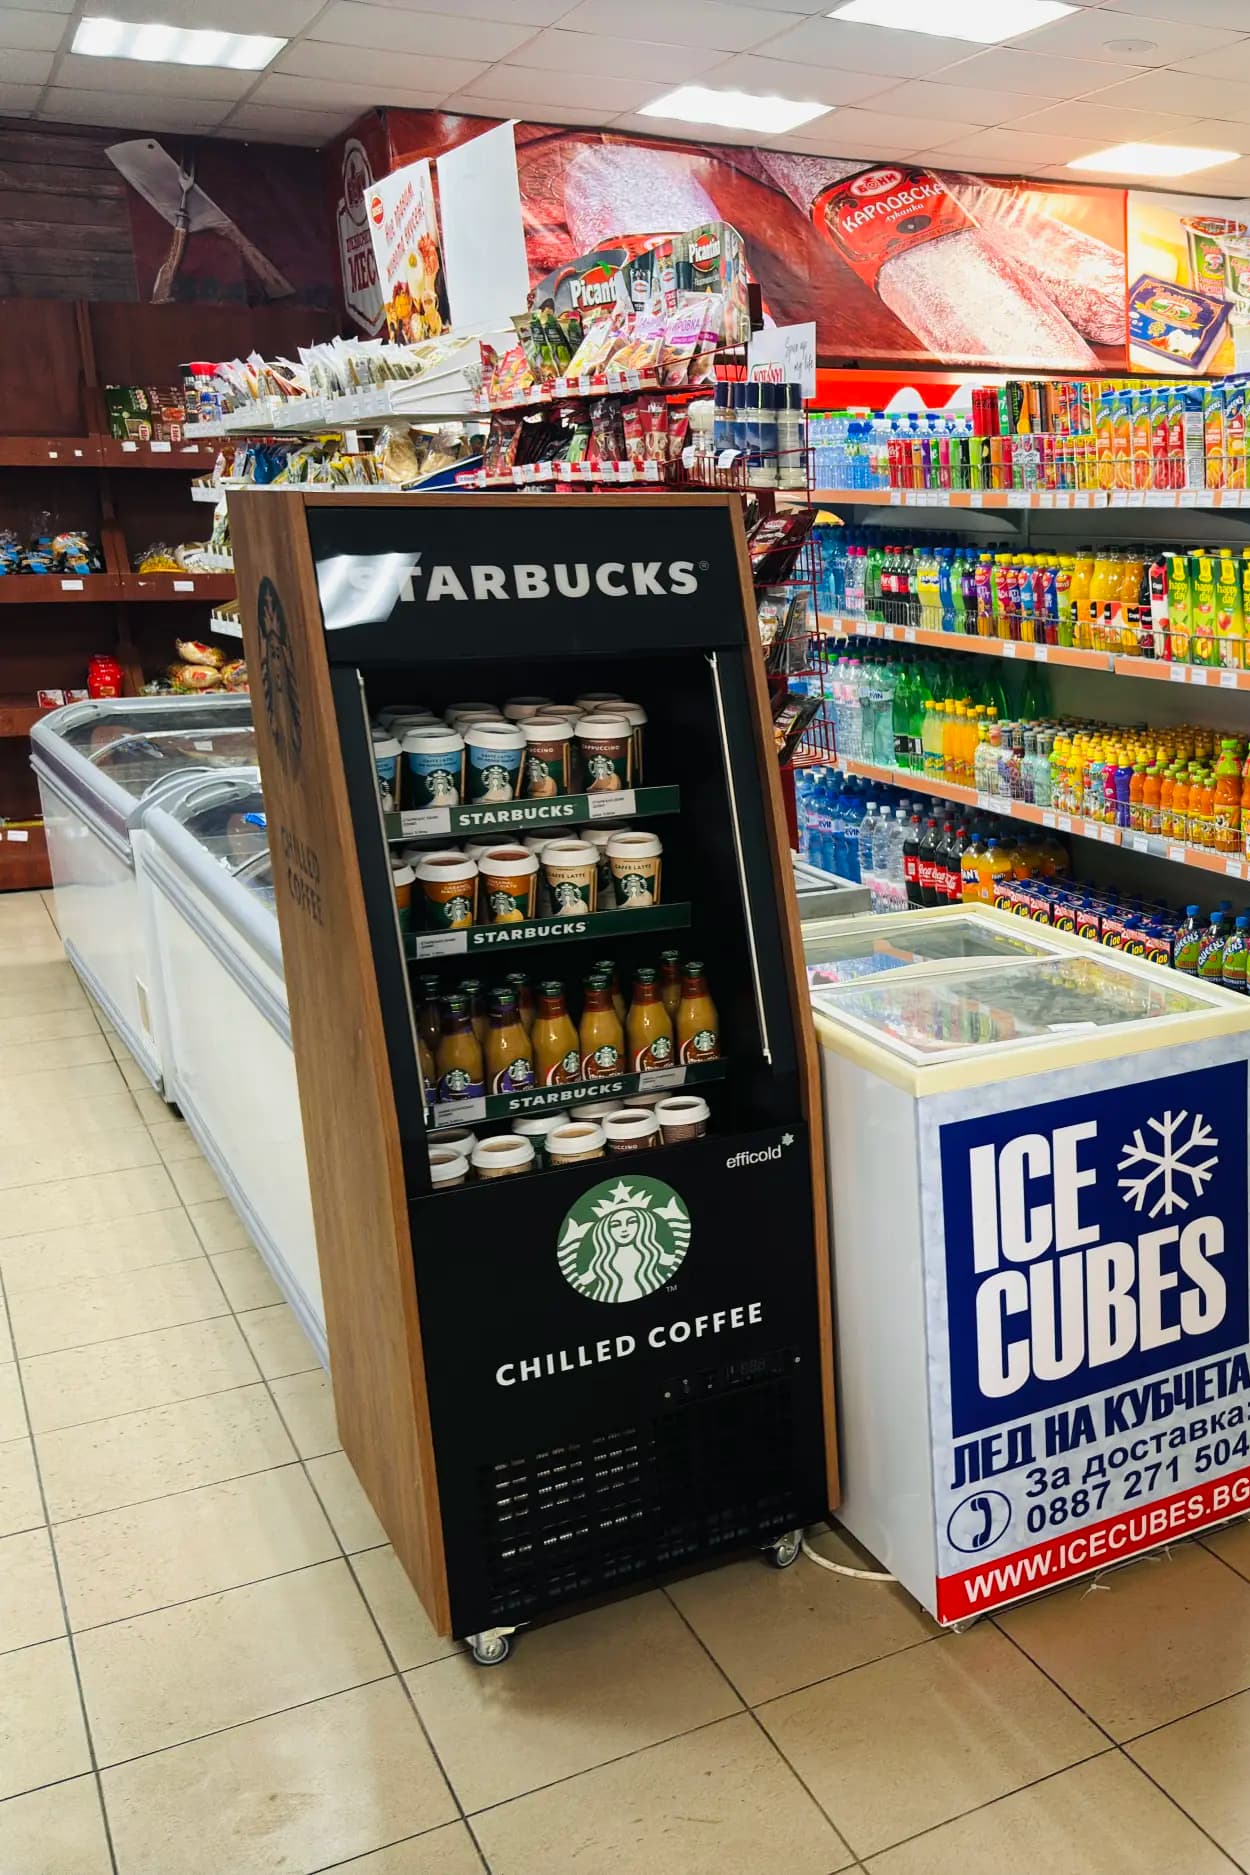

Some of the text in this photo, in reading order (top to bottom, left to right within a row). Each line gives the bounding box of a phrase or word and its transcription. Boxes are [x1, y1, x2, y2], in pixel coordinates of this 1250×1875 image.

[569, 279, 623, 308] Picant
[349, 558, 699, 603] TARBUCKS
[1174, 589, 1187, 601] day
[1199, 590, 1213, 602] day
[1222, 594, 1236, 607] day
[459, 803, 575, 827] STARBUCKS
[280, 824, 321, 889] CHILLED
[286, 865, 324, 928] COFFEE
[473, 921, 587, 945] STARBUCKS
[1103, 931, 1121, 947] Ciao
[1124, 940, 1144, 956] Ciao
[1148, 949, 1169, 965] Ciao
[508, 1080, 624, 1111] STARBUCKS
[725, 1146, 783, 1170] efficold
[968, 1119, 1101, 1275] ICE
[666, 1283, 678, 1293] TM
[975, 1215, 1228, 1400] CUBES
[495, 1301, 764, 1388] CHILLED COFFEE
[951, 1421, 1036, 1489] ЛЕД
[1045, 1404, 1097, 1458] НА
[1025, 1466, 1071, 1498] За
[1026, 1430, 1250, 1533] 0887 271 504
